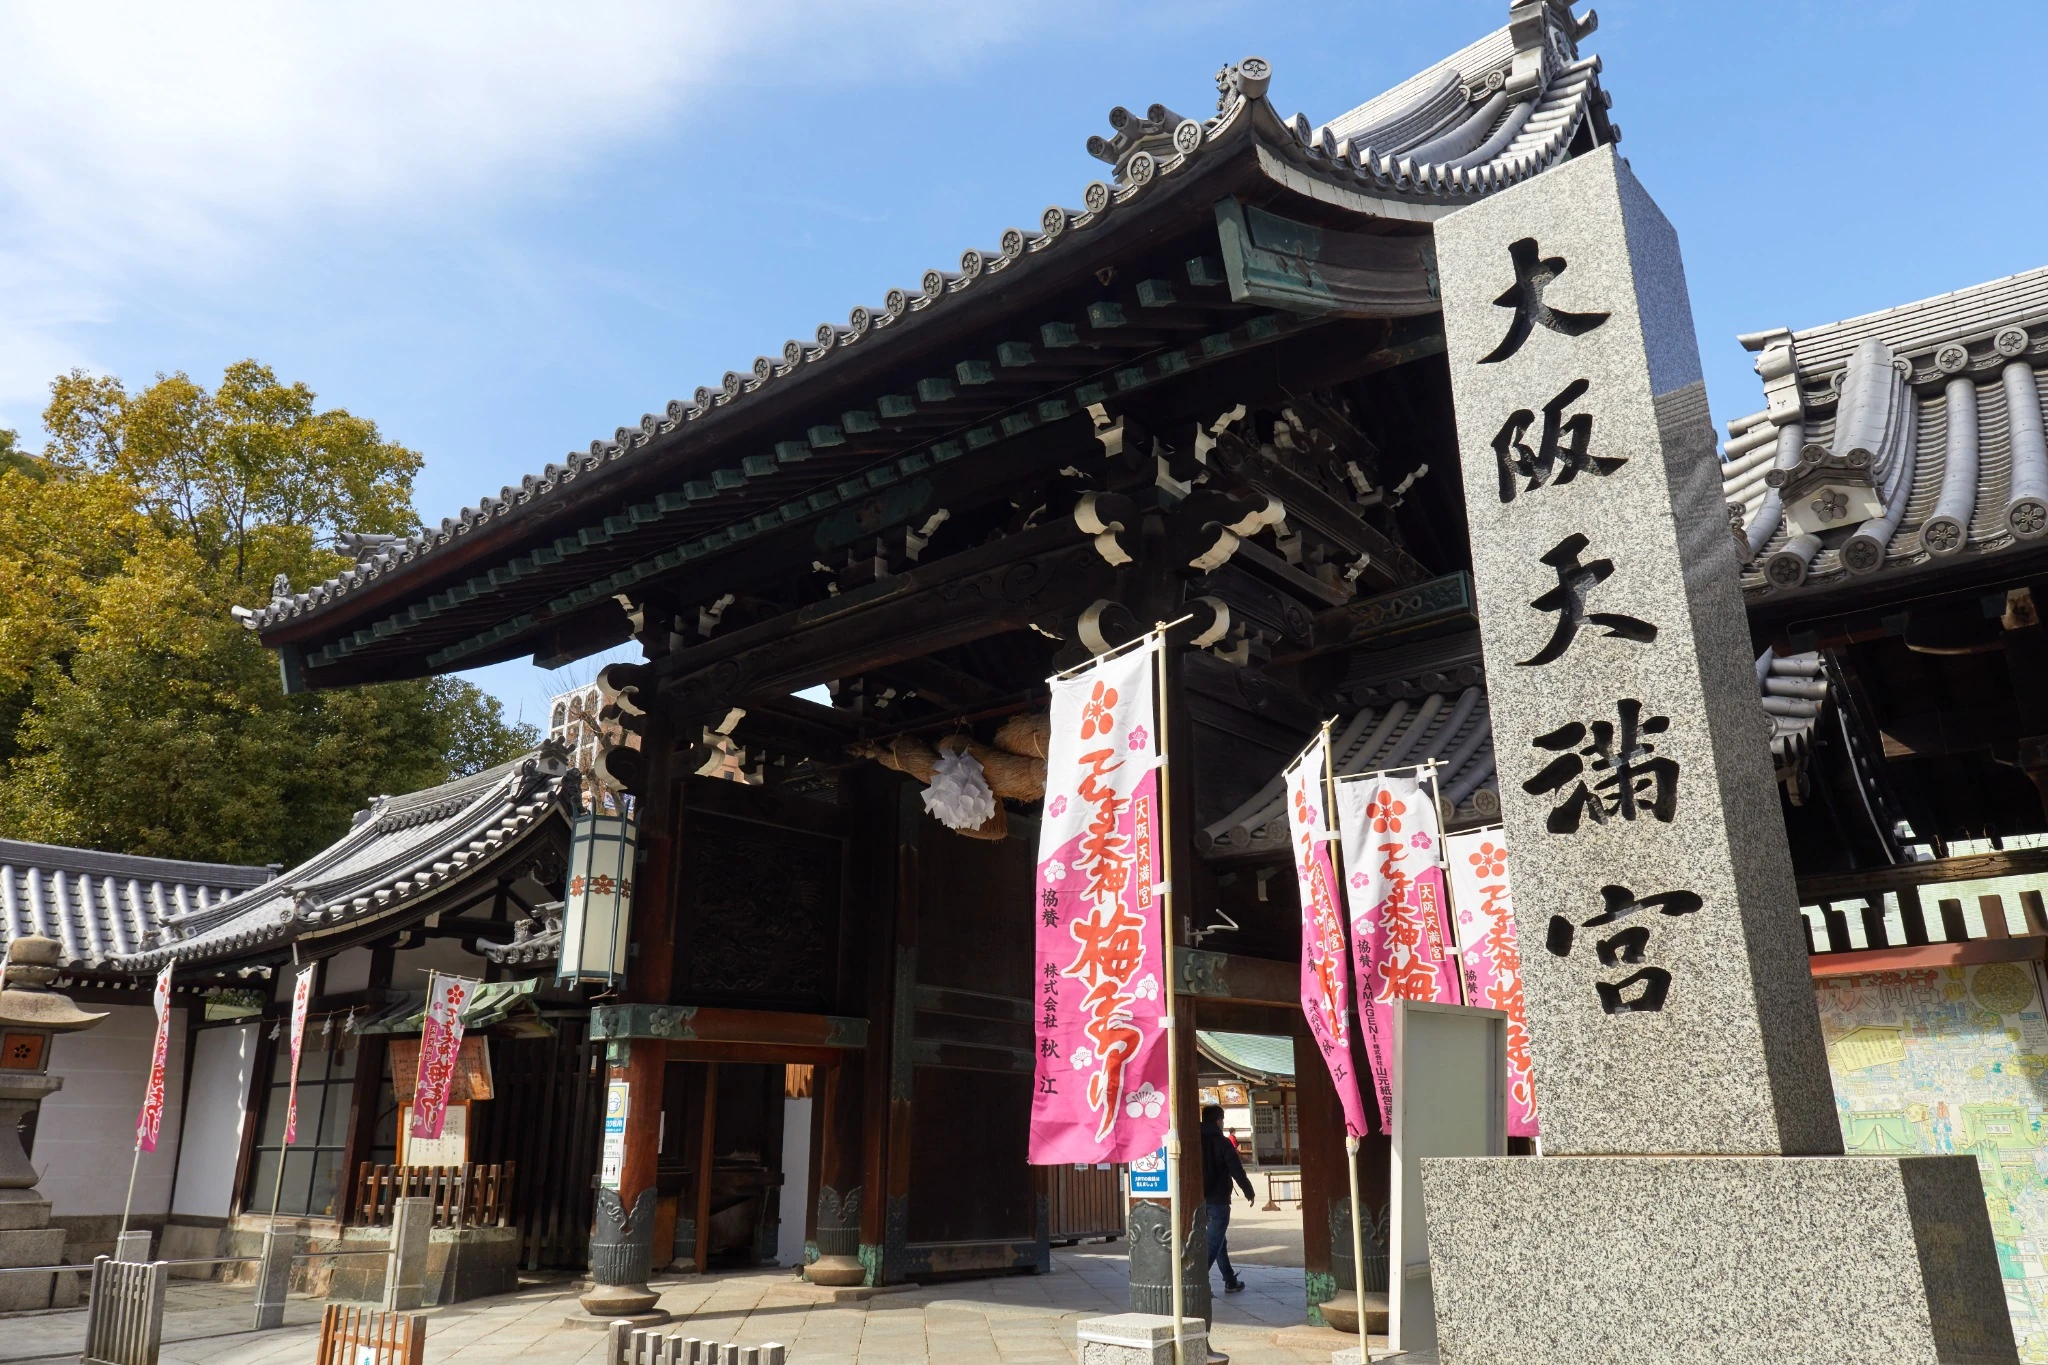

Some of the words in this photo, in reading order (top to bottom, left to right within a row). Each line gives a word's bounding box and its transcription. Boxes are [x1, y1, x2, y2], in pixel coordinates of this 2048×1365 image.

[1479, 237, 1704, 1015] 大阪天満宮
[1136, 801, 1150, 905] 大阪天満宮
[1041, 888, 1060, 928] 協賛
[1421, 885, 1443, 958] 大阪天満宮
[1357, 939, 1373, 968] 協賛
[1043, 962, 1060, 1029] 株式会社
[1362, 973, 1379, 1042] YAMAGEN!
